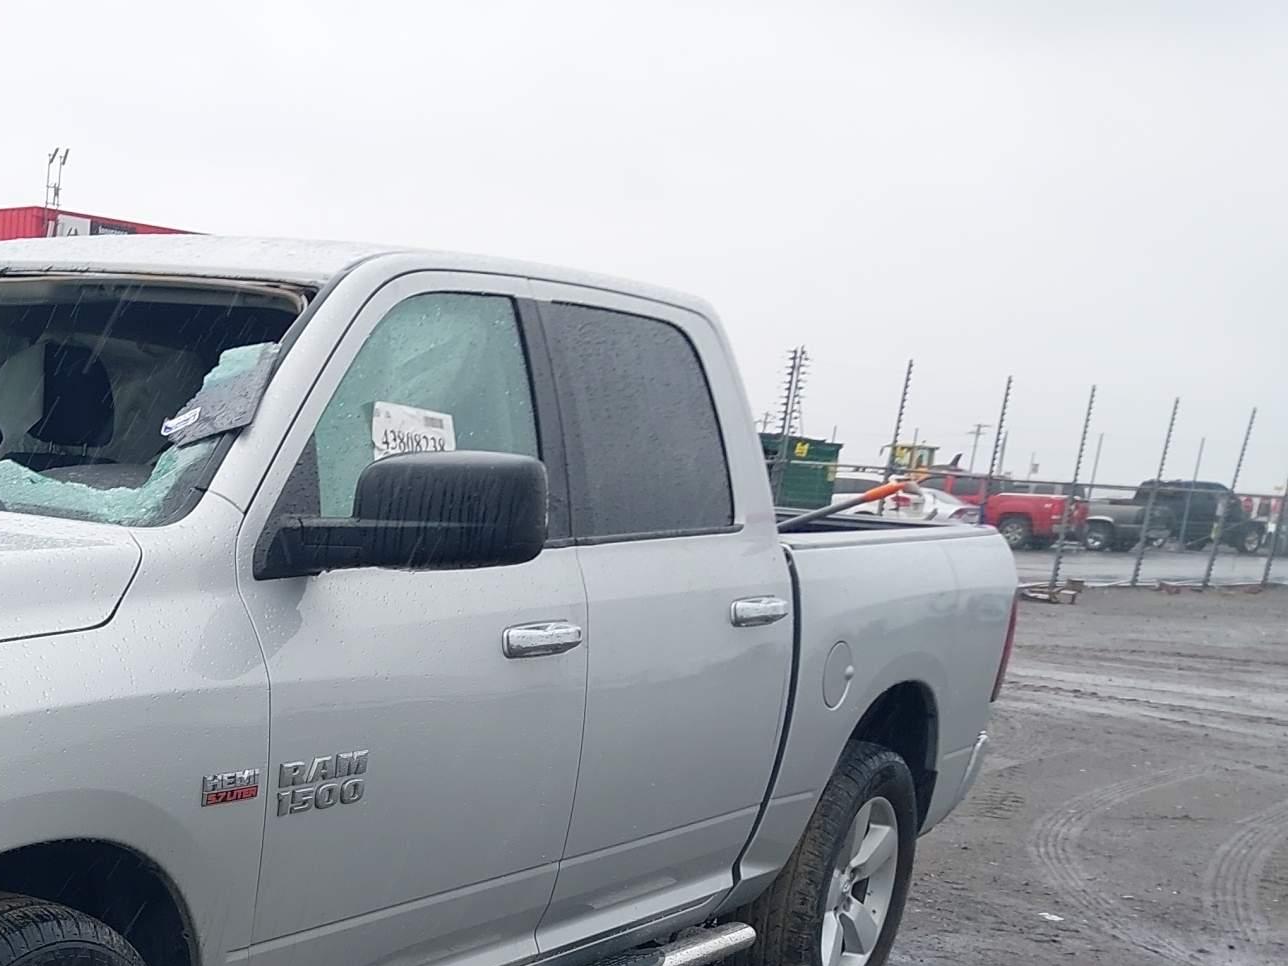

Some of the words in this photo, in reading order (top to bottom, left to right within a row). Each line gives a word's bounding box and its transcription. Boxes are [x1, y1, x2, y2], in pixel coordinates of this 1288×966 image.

[203, 768, 260, 793] HEMI
[279, 750, 369, 788] RAM
[227, 786, 258, 802] LITER
[277, 778, 364, 817] 1500
